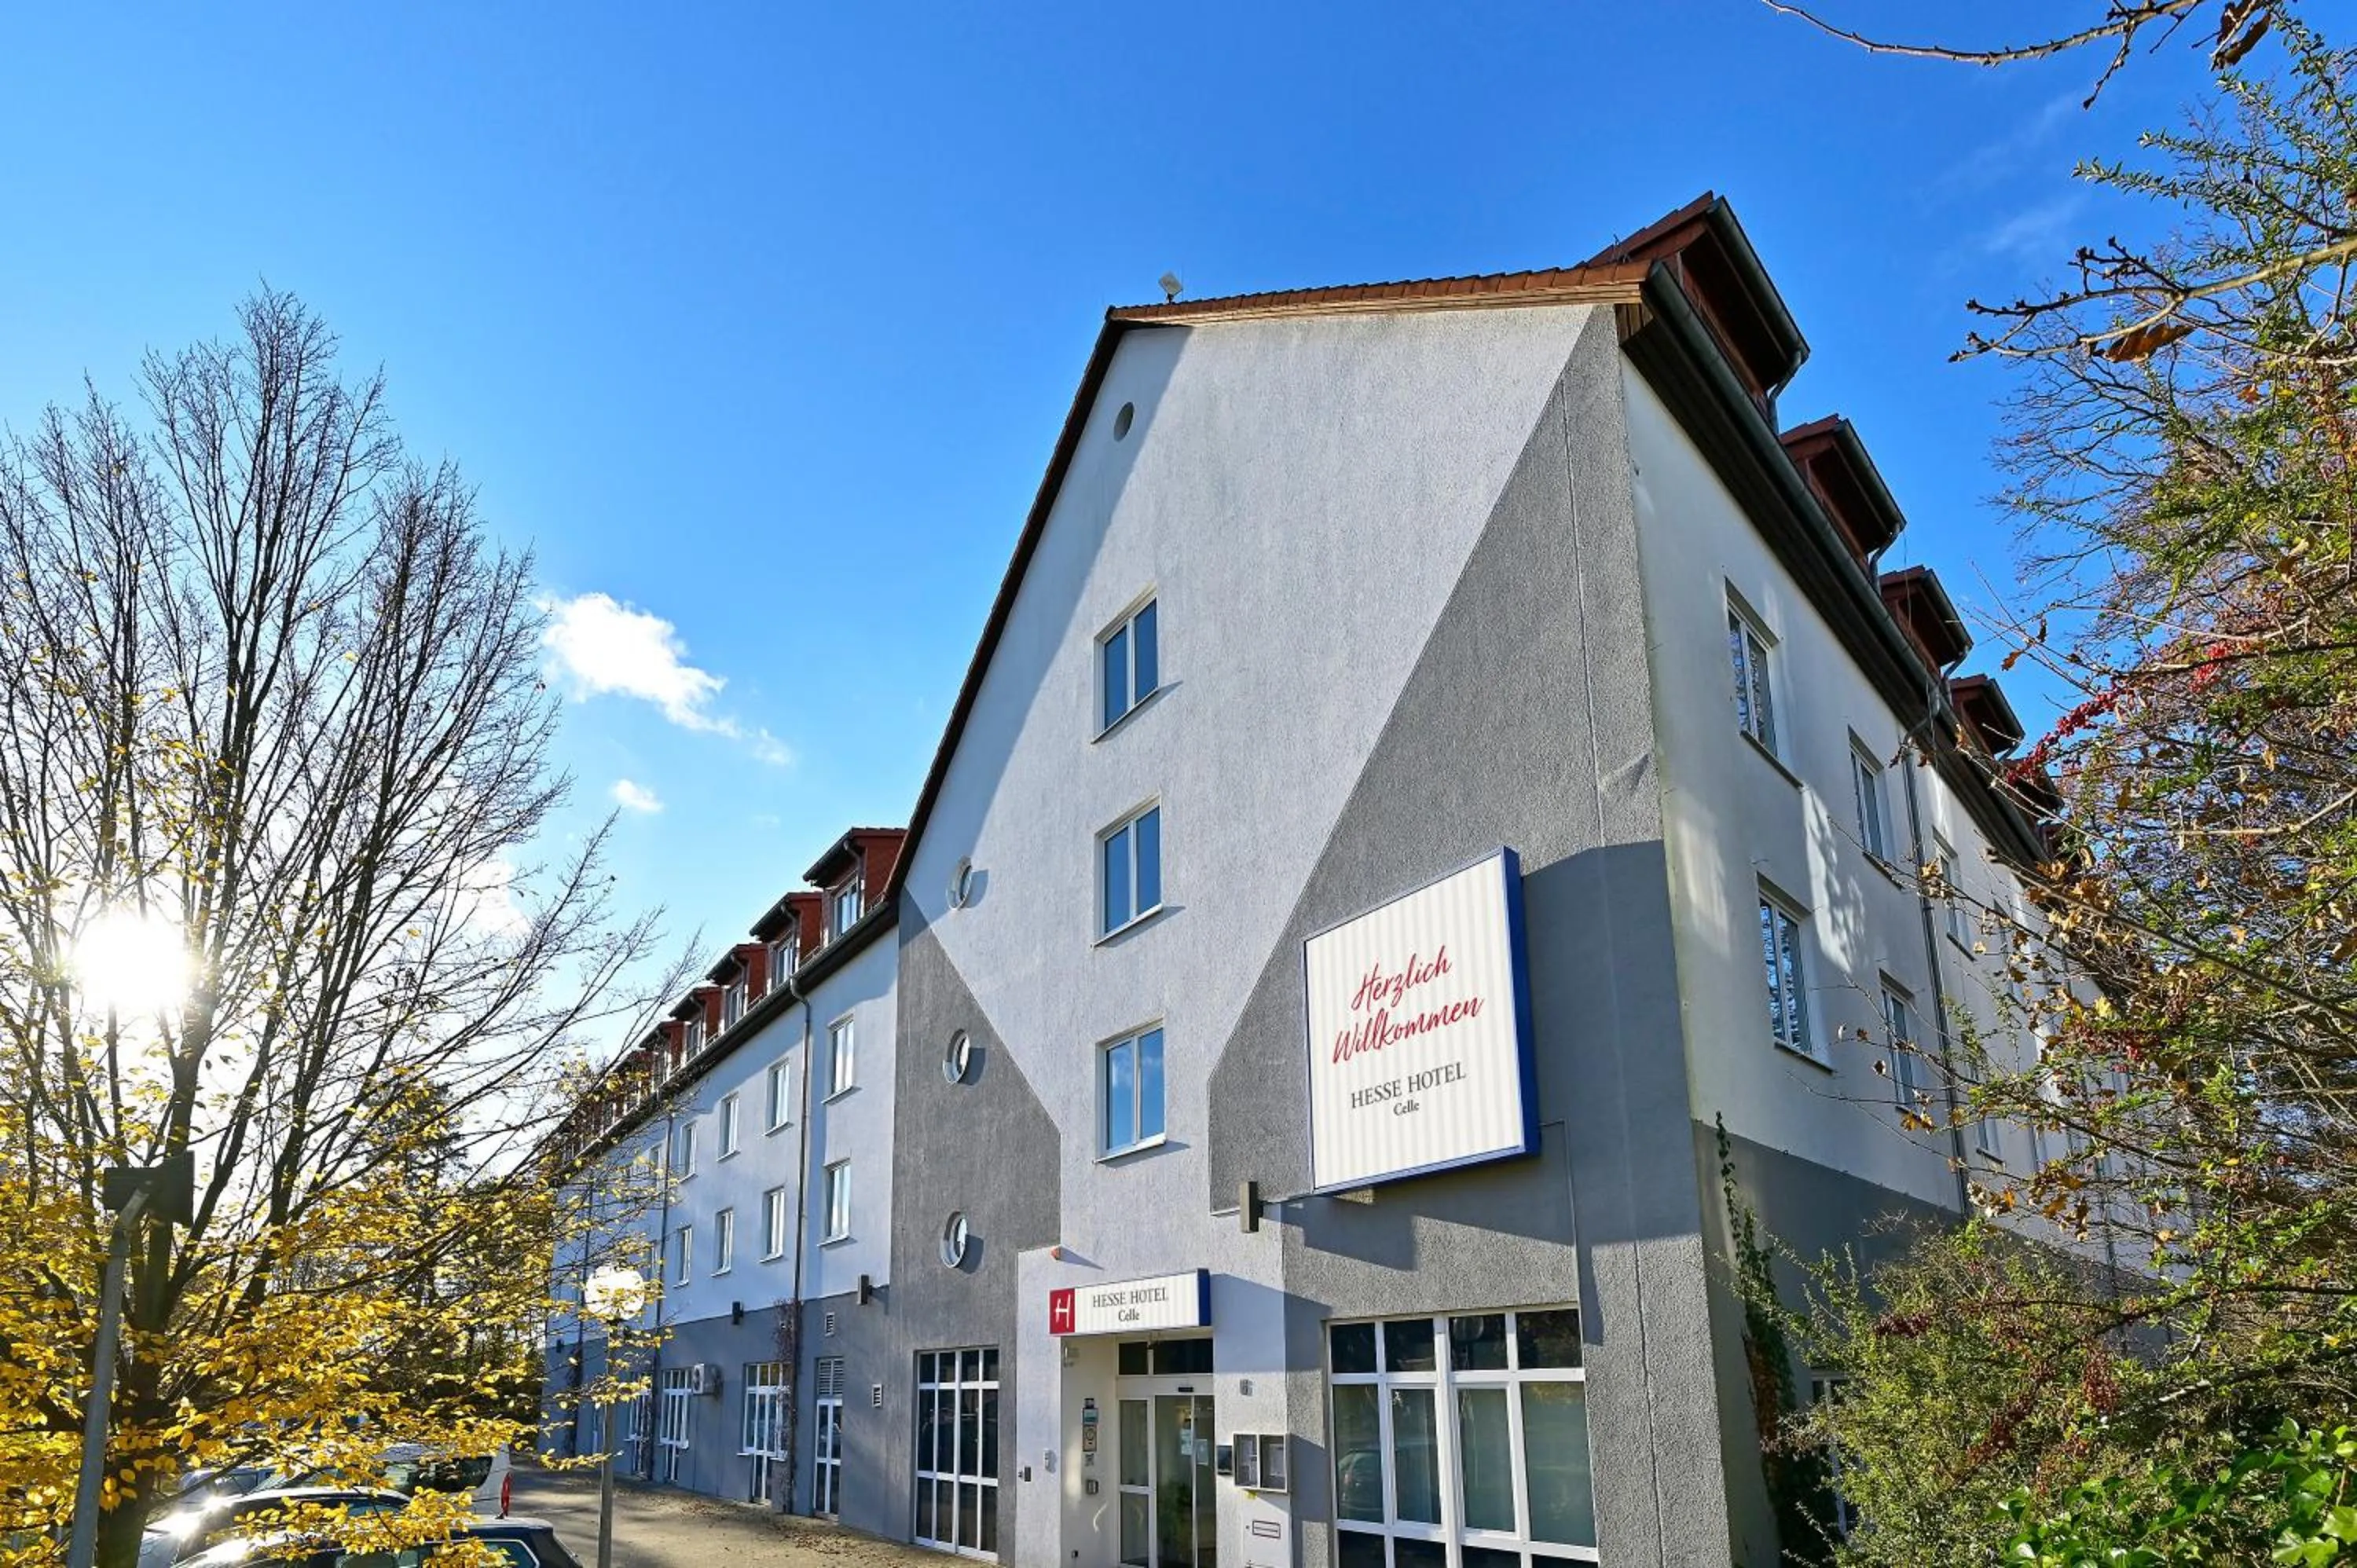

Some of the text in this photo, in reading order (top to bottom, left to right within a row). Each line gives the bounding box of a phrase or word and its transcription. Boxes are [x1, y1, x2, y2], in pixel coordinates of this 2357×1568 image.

[1351, 945, 1452, 1012] Herzlich
[1332, 997, 1484, 1064] Willkommen
[1351, 1062, 1466, 1108] HESSE HOTEL
[1393, 1100, 1420, 1116] Celle
[1093, 1287, 1169, 1307] HESSE HOTEL
[1118, 1310, 1140, 1322] Celle
